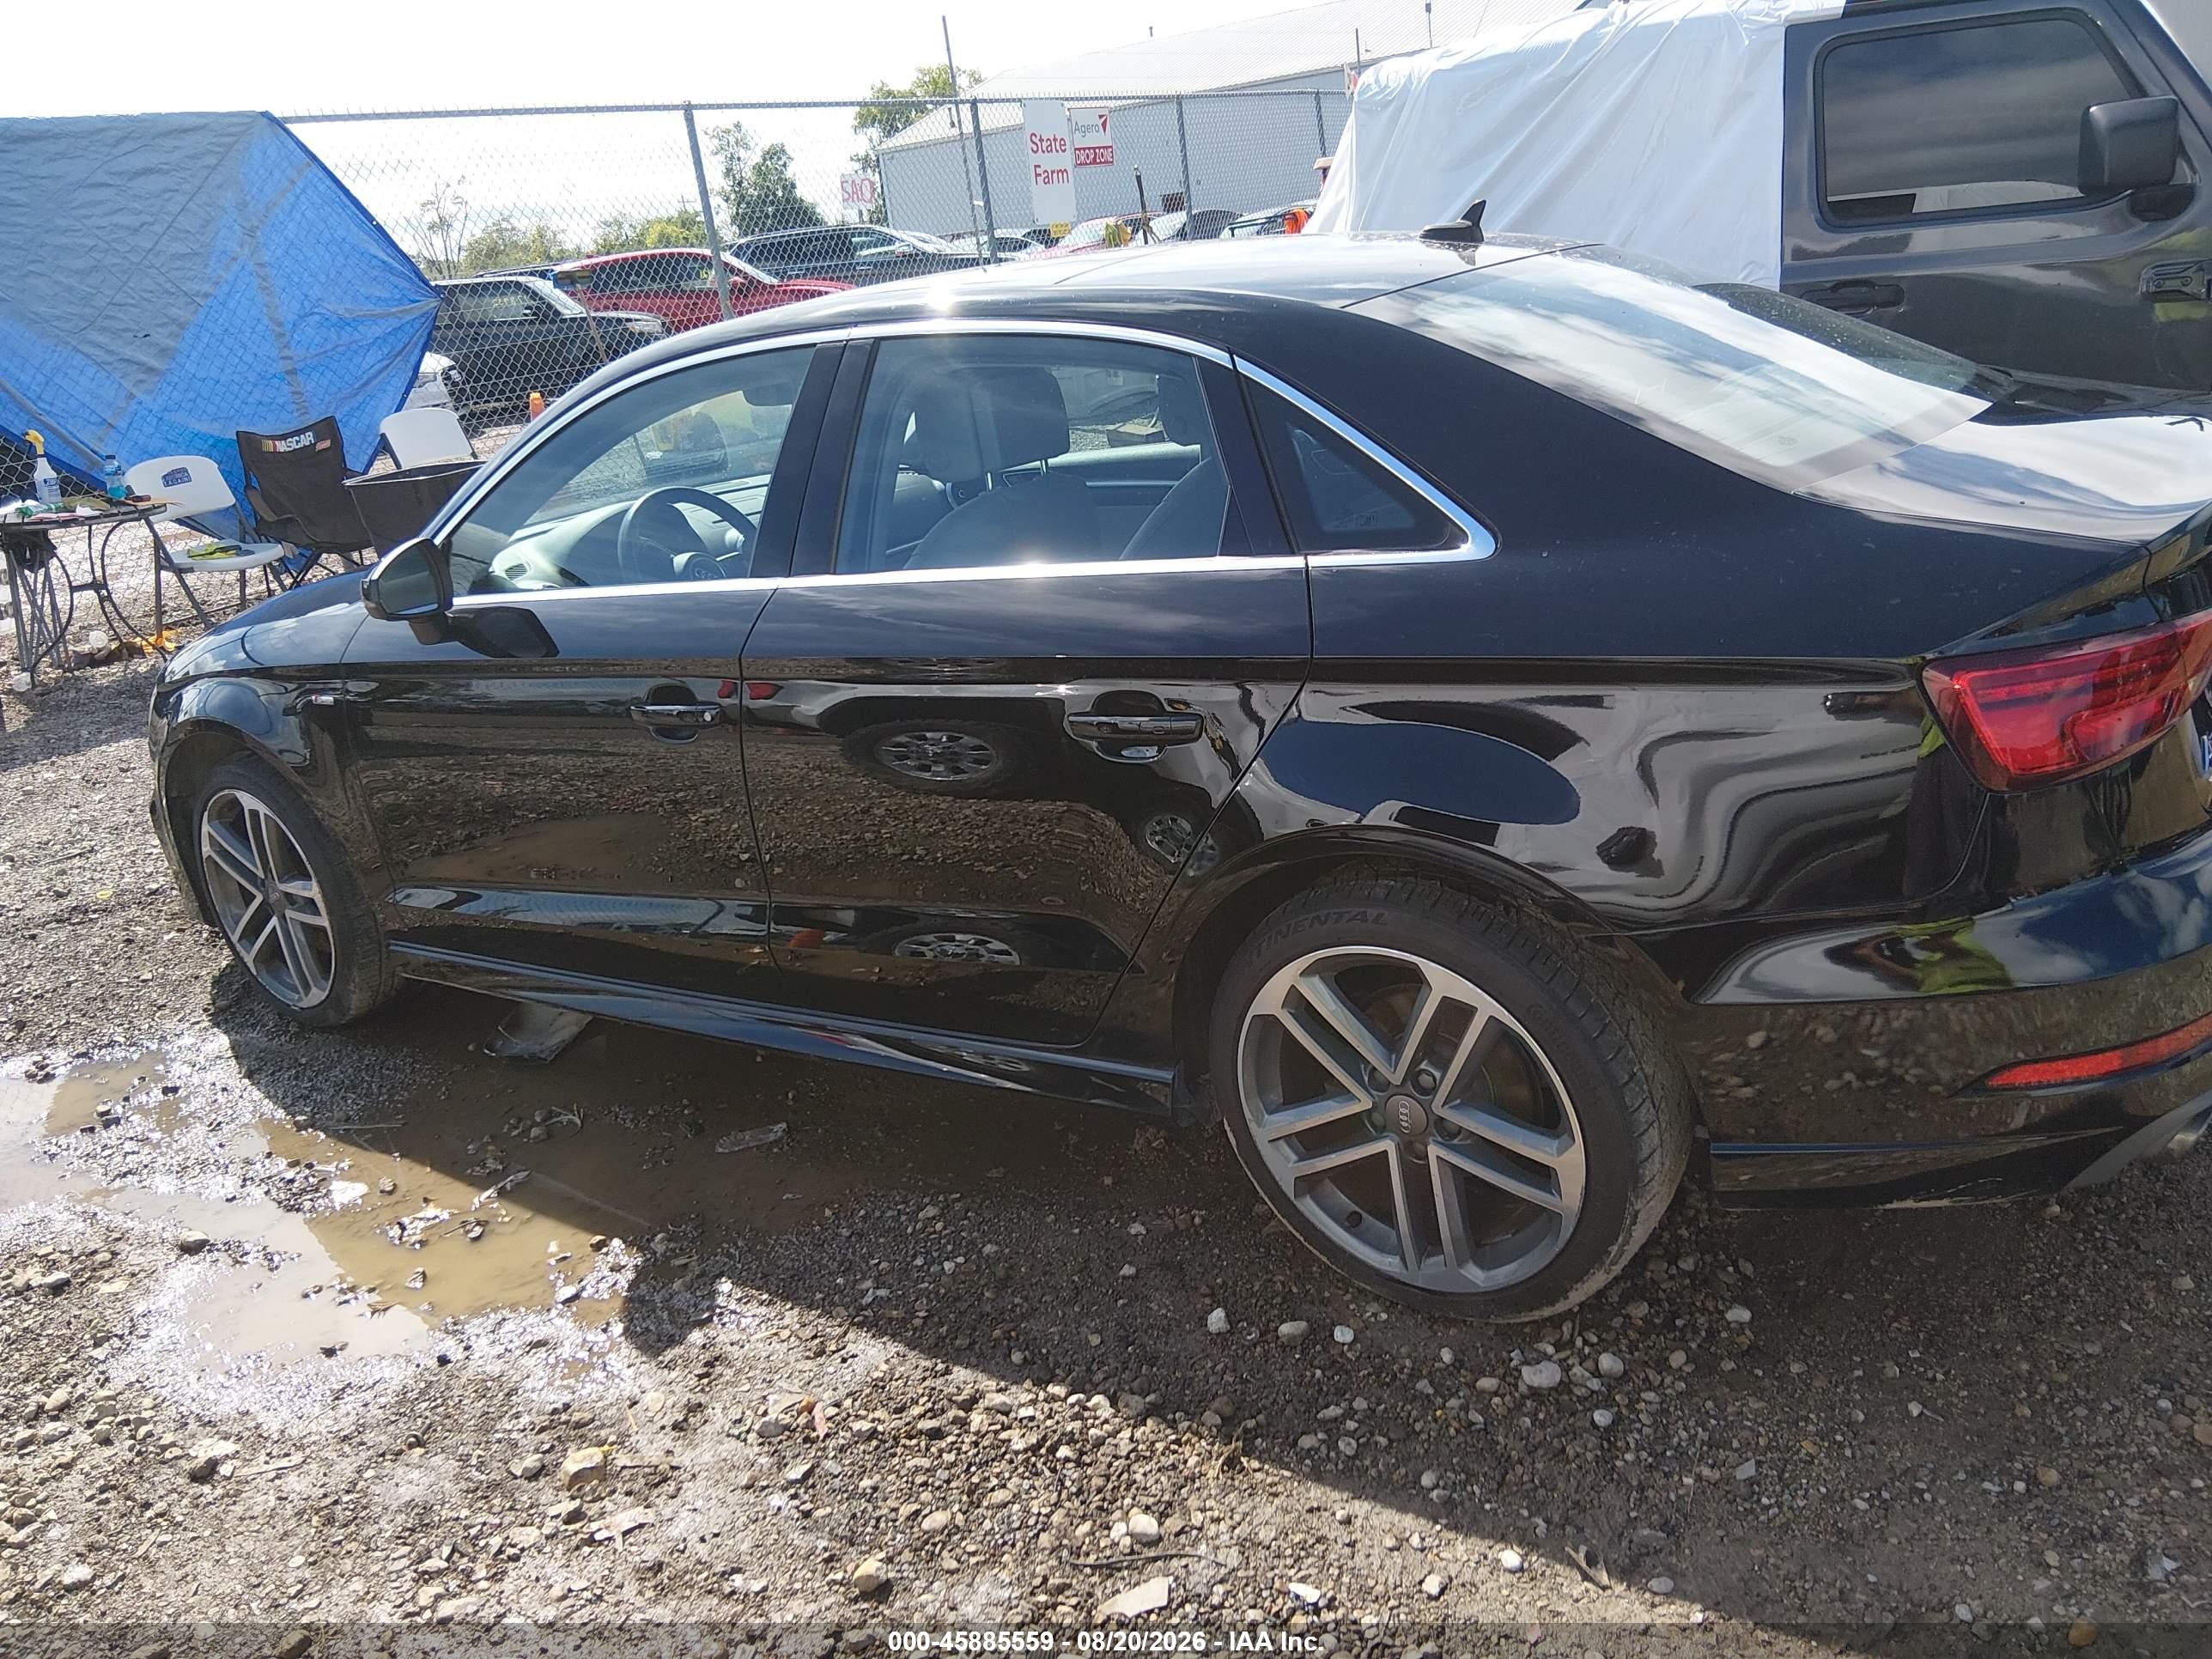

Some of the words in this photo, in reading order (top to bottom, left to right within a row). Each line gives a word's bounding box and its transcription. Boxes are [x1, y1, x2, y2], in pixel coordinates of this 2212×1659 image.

[1074, 120, 1100, 137] Agero
[1030, 132, 1067, 155] State
[1075, 149, 1095, 164] DROP
[1095, 148, 1113, 163] ZONE
[1033, 164, 1070, 185] Farm
[276, 431, 315, 453] NASCAR
